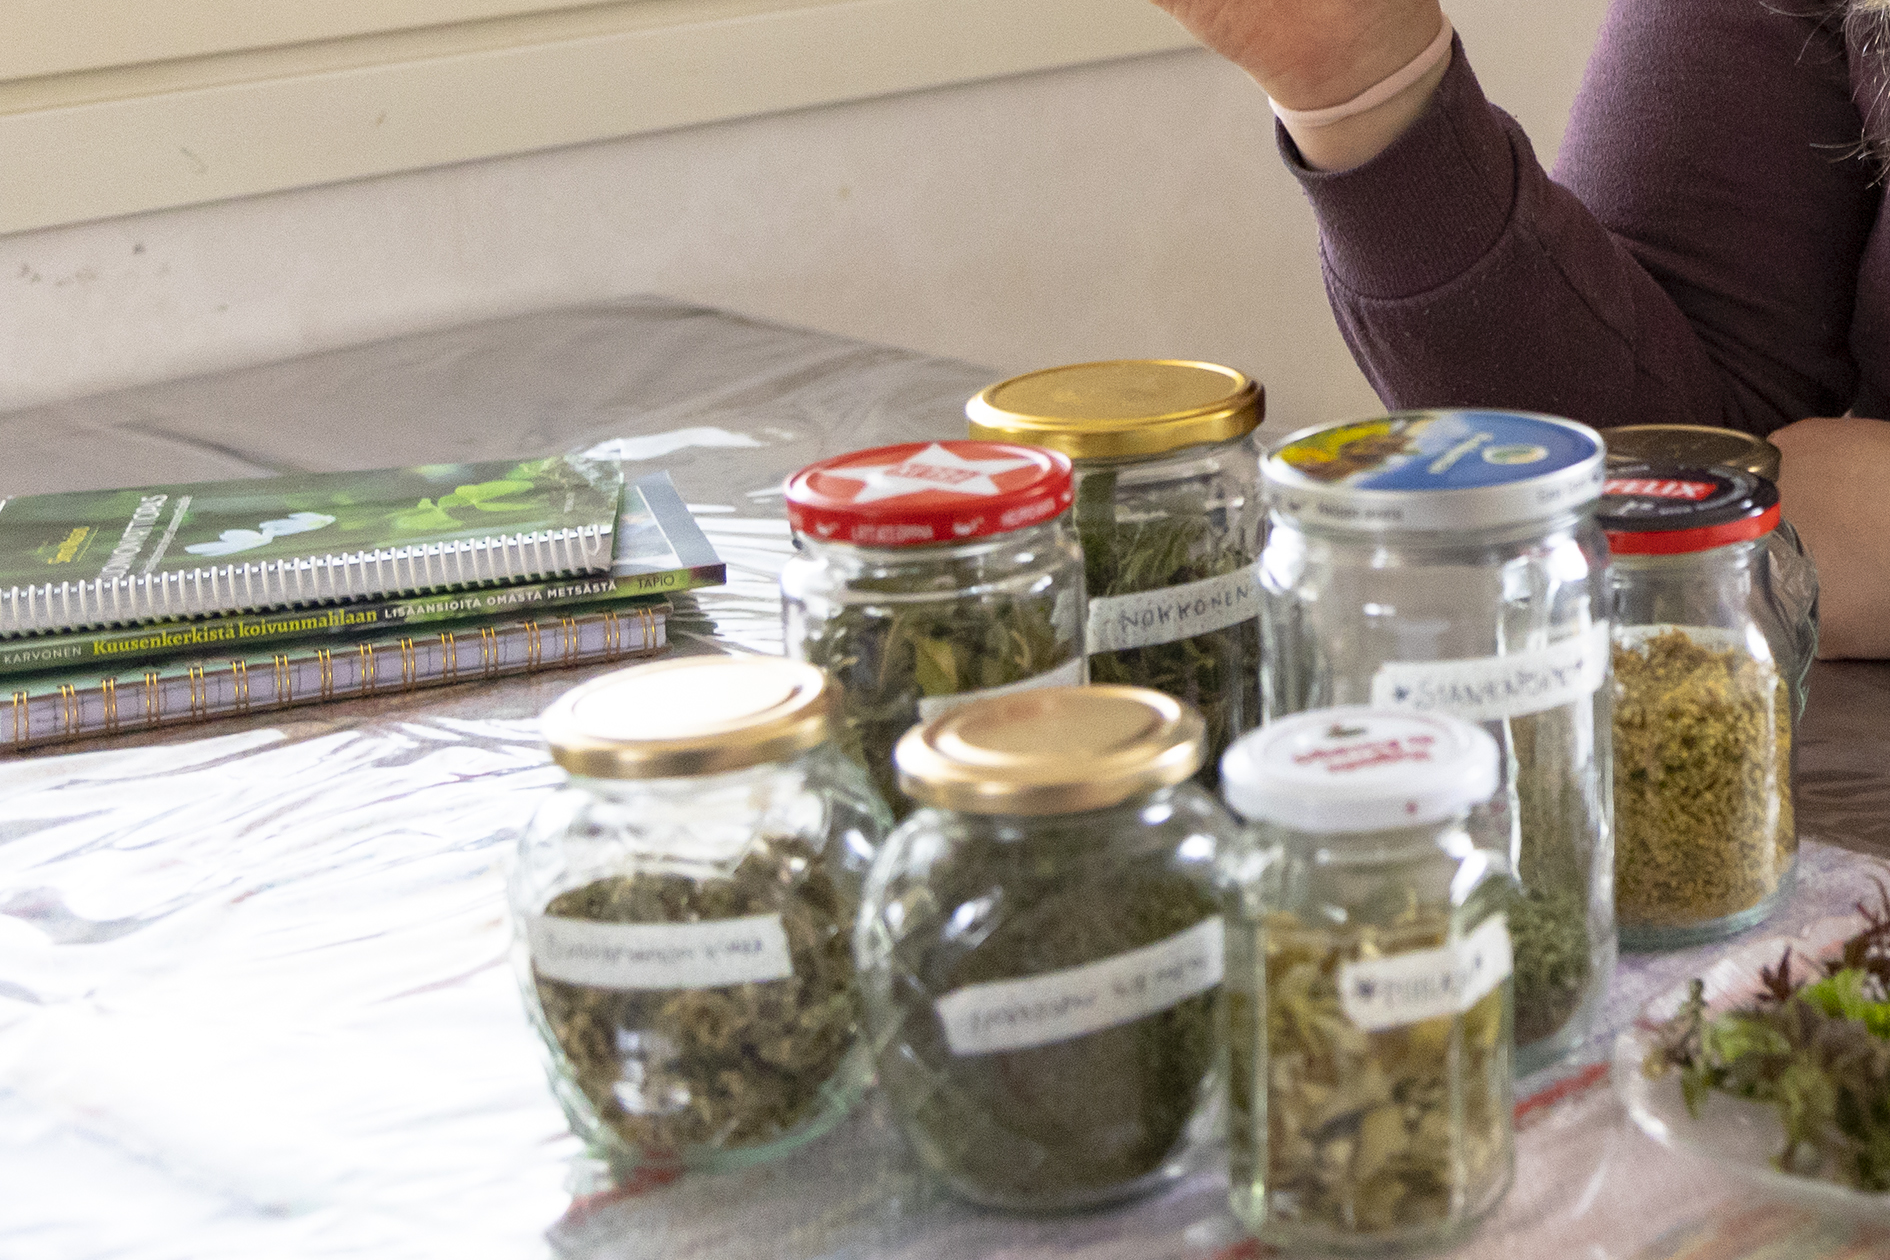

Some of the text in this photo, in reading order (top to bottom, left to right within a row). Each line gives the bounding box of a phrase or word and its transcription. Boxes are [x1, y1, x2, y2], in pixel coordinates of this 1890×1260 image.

[4, 645, 82, 664] KARVONEN
[93, 623, 235, 655] Kuusenkerkistä
[238, 609, 377, 638] koivunmahlaan
[486, 591, 543, 607] OMASTA
[637, 574, 675, 589] TAPIO
[1119, 586, 1249, 633] NOKKONEN
